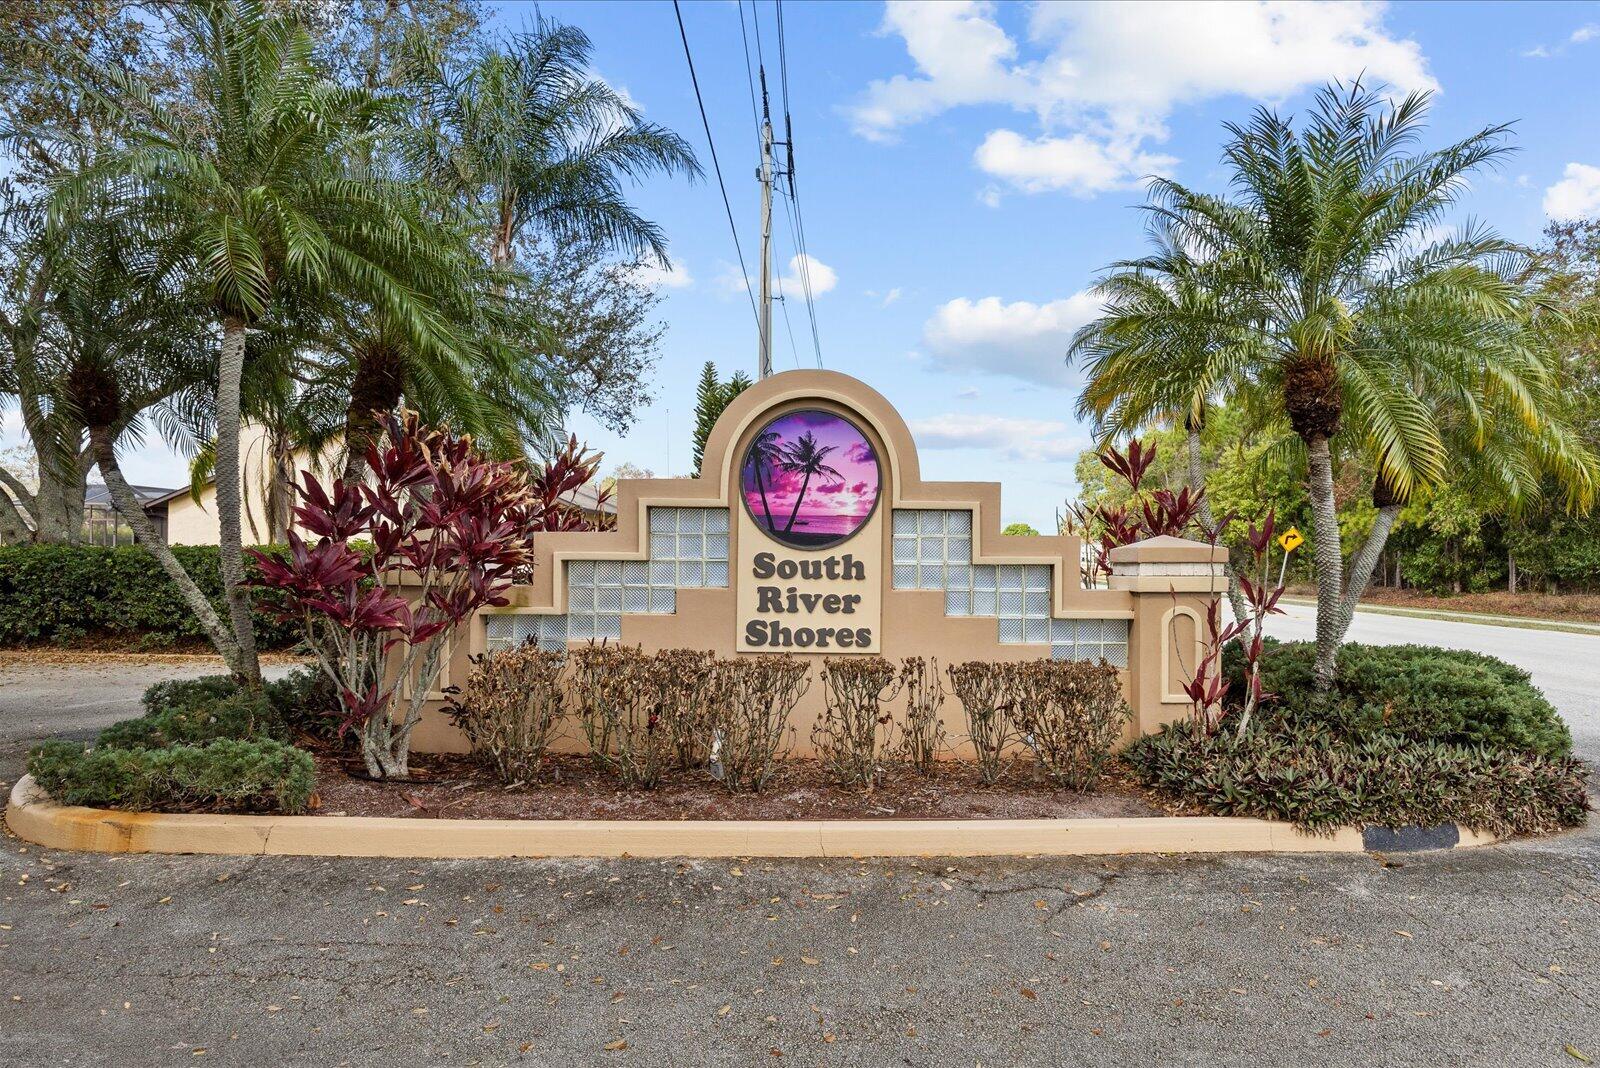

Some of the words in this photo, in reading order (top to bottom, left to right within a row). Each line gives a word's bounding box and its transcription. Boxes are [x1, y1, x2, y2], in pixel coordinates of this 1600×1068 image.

[753, 552, 865, 580] South
[756, 586, 861, 614] River
[745, 620, 871, 647] Shores
